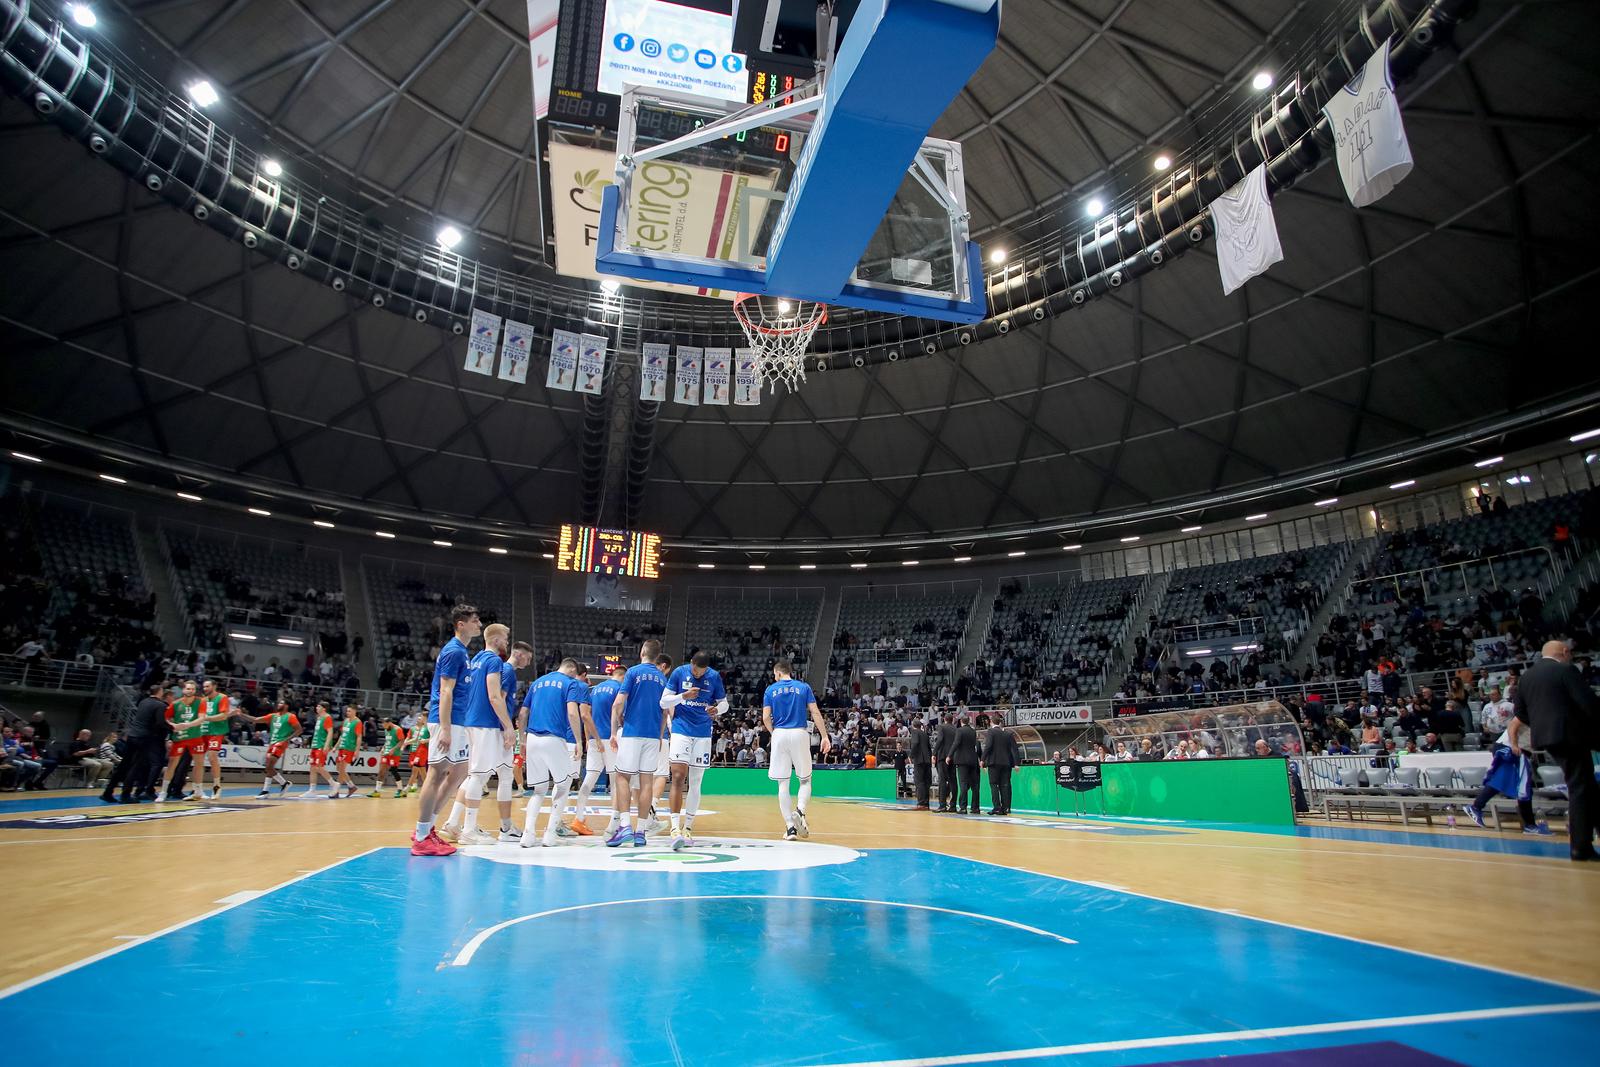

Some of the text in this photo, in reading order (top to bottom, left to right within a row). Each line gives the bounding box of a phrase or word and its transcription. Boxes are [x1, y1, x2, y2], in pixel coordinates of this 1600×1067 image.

[558, 89, 583, 98] HOME
[775, 134, 788, 152] 0
[1018, 710, 1077, 721] SUPERNOVA
[703, 752, 710, 765] 3
